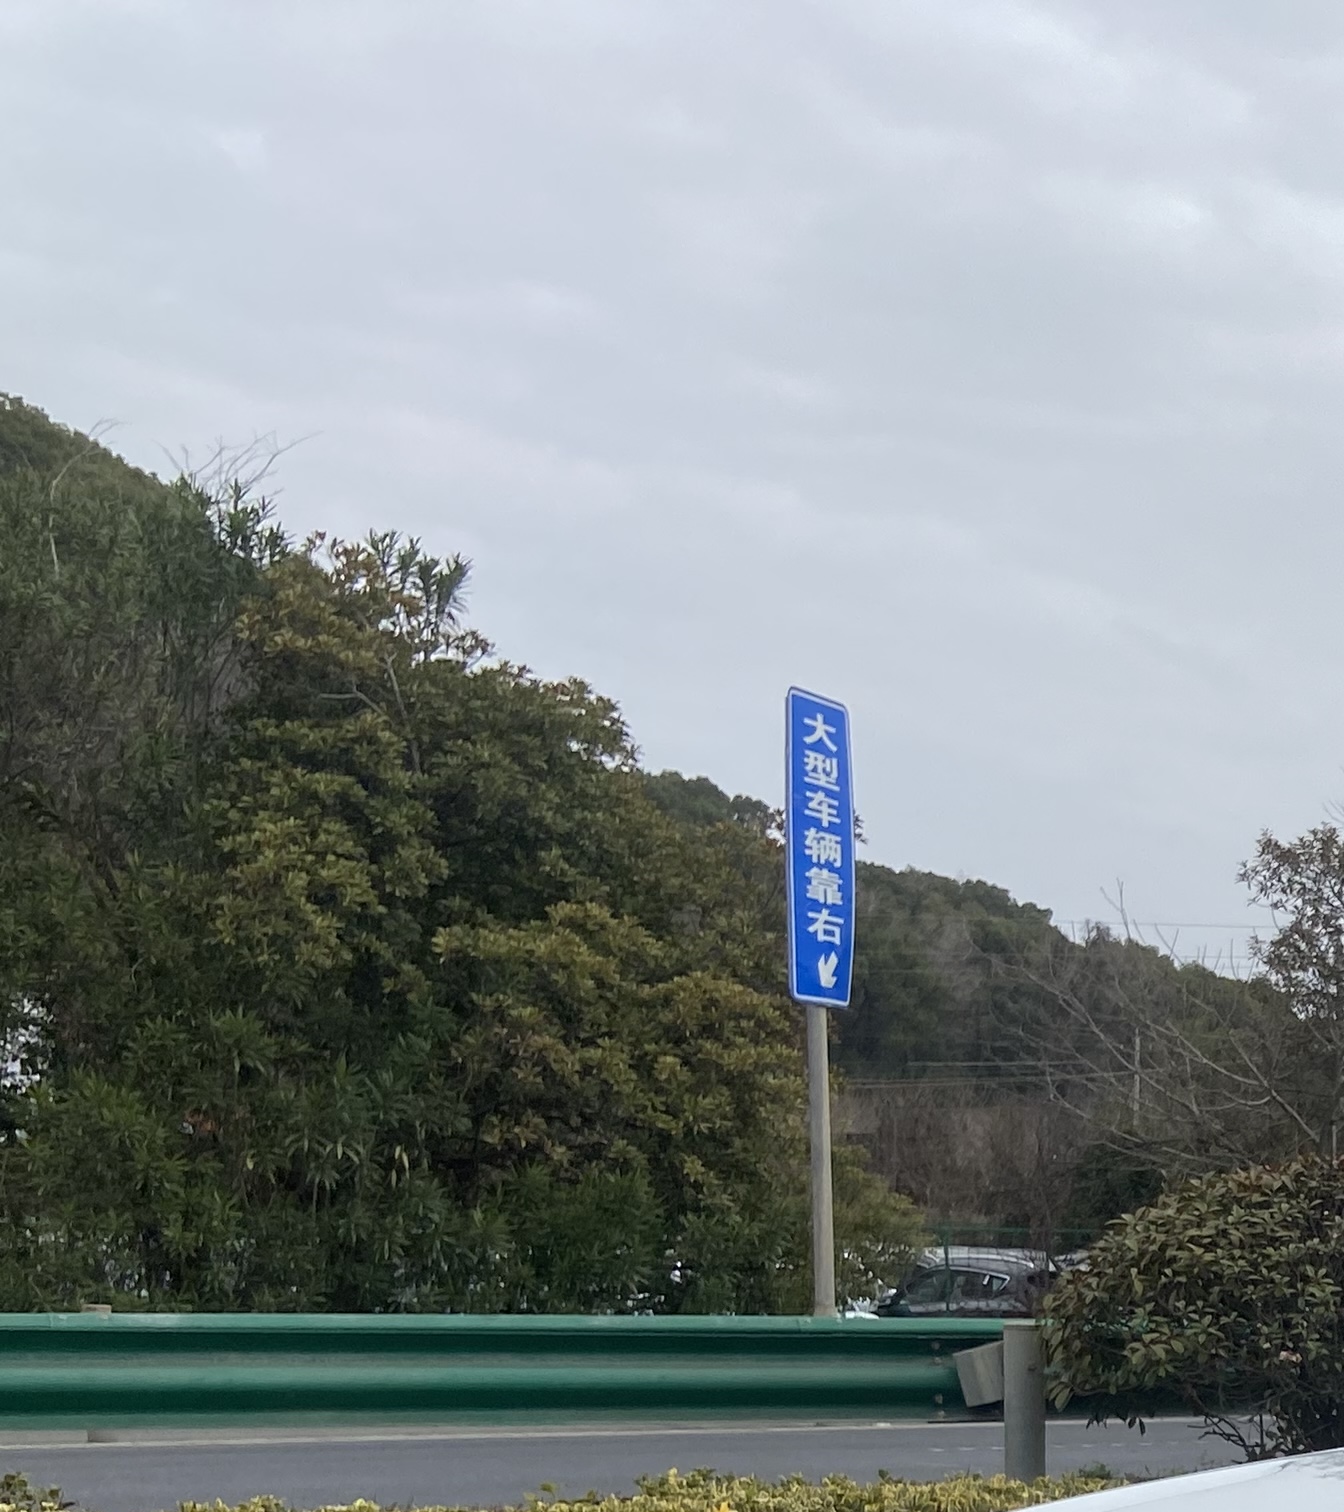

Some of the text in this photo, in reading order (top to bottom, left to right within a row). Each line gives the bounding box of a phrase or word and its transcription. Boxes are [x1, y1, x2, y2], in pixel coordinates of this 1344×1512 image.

[803, 712, 844, 946] 大型车辆靠右
